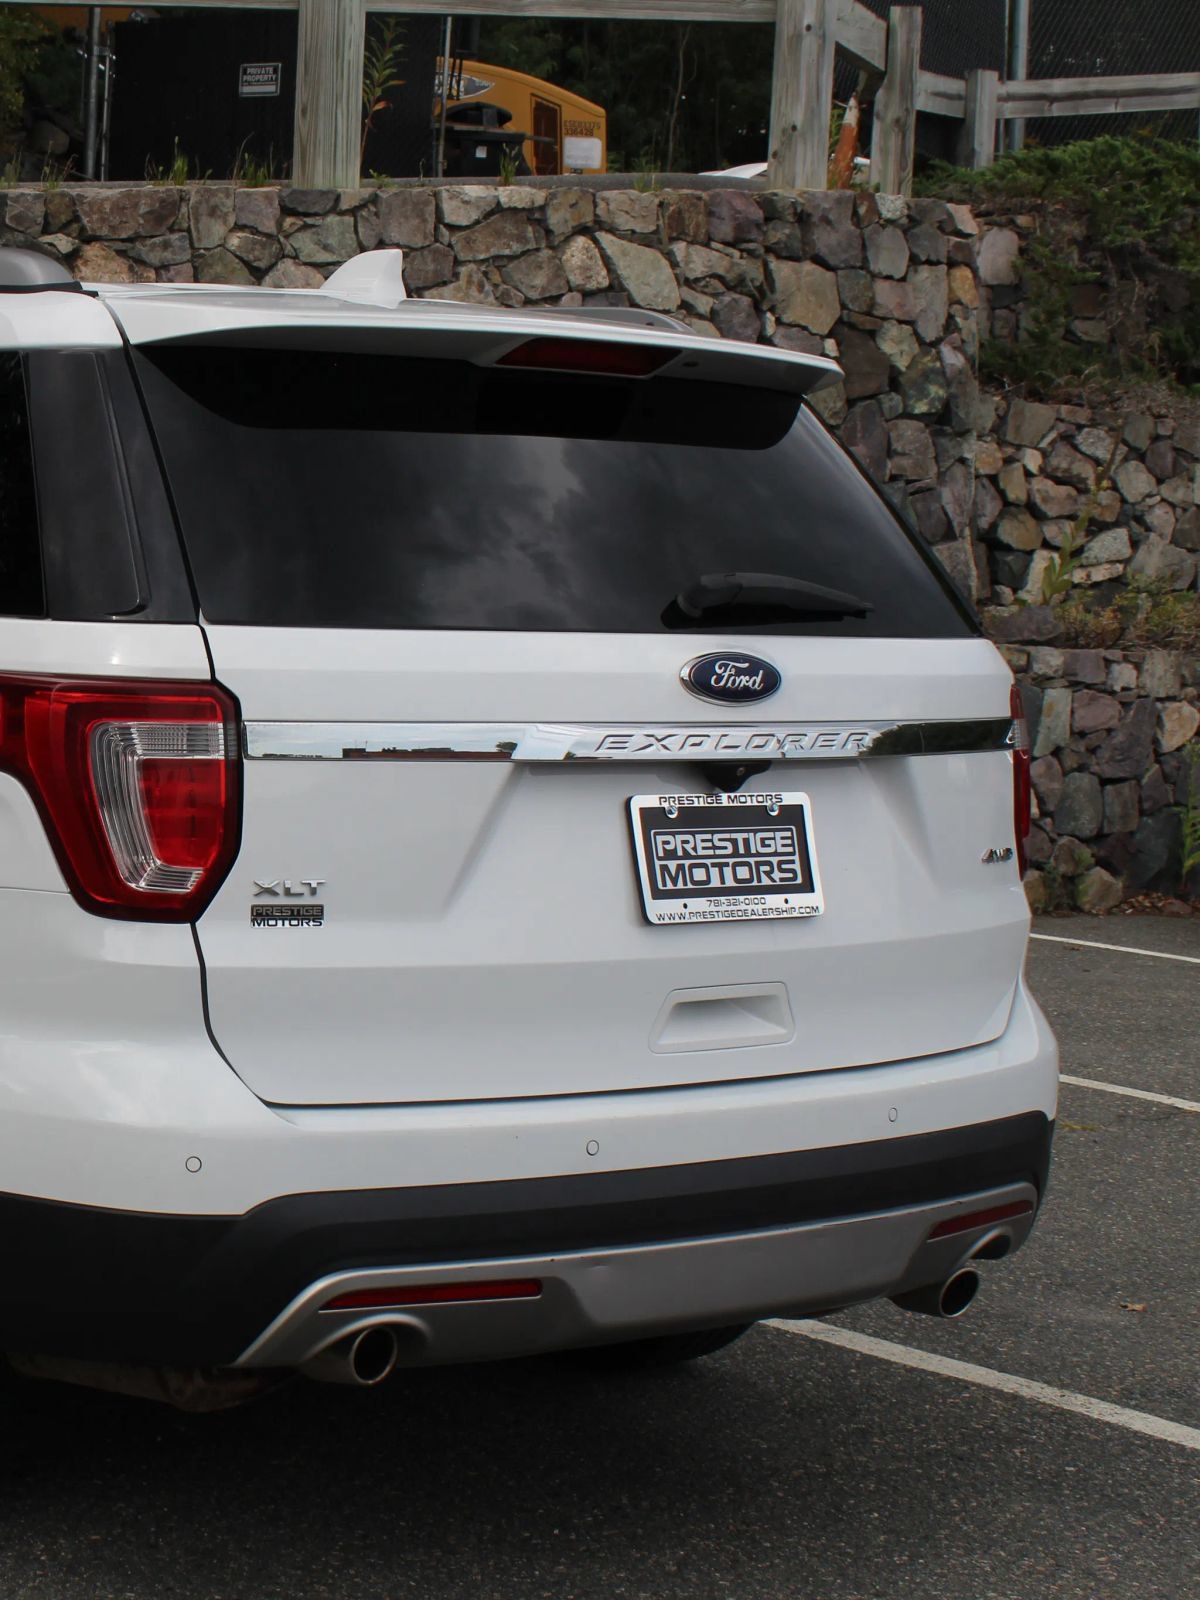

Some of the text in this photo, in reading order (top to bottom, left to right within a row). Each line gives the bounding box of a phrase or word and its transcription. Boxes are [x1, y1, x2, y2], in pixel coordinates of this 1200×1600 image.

[710, 660, 764, 690] Ford
[594, 732, 872, 752] EXPLORER
[658, 793, 783, 806] PRESTIGE MOTORS
[655, 831, 794, 857] PRESTIGE
[659, 858, 799, 887] MOTORS
[253, 880, 326, 897] XLT
[705, 896, 767, 908] 781-321-0100
[253, 906, 323, 916] PRESTIGE
[655, 905, 820, 922] WWW.PRESTIGEDEALERSHIP.COM
[252, 917, 323, 927] MOTORS
